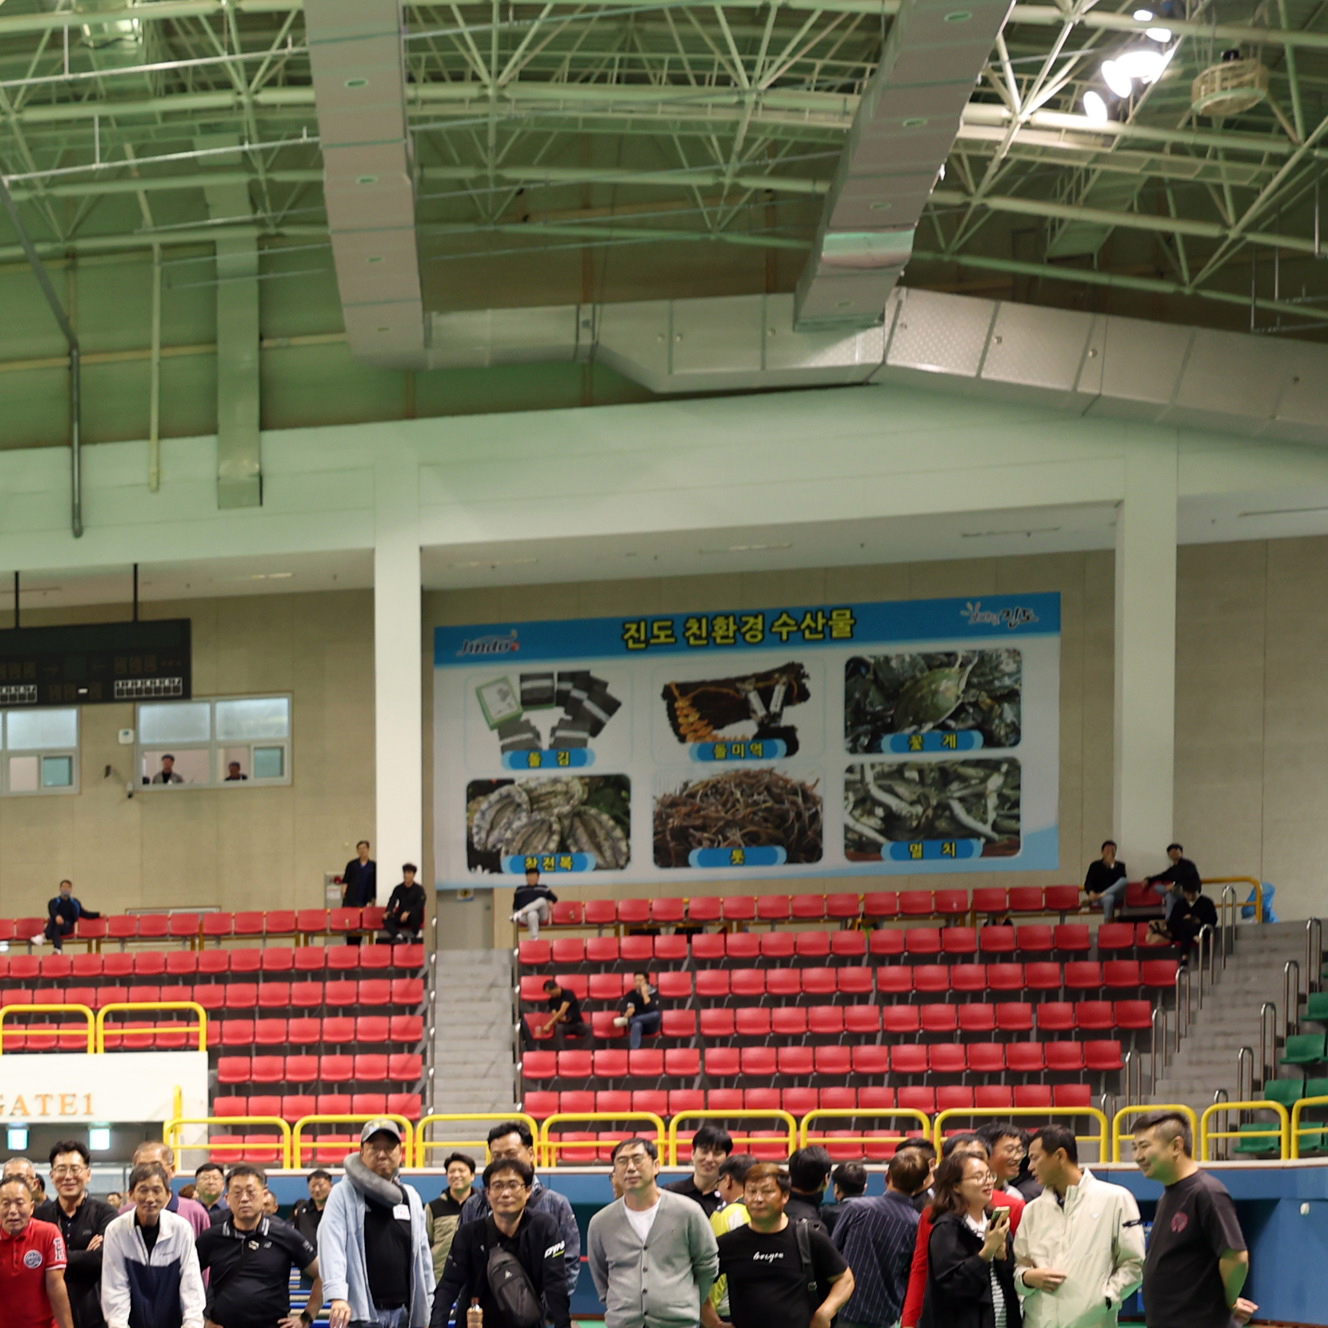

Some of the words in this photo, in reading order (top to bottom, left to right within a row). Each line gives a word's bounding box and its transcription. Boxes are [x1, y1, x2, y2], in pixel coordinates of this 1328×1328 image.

[622, 619, 678, 651] 진도
[683, 613, 765, 646] 친환경
[770, 607, 856, 641] 수산물
[456, 639, 512, 656] Jindo
